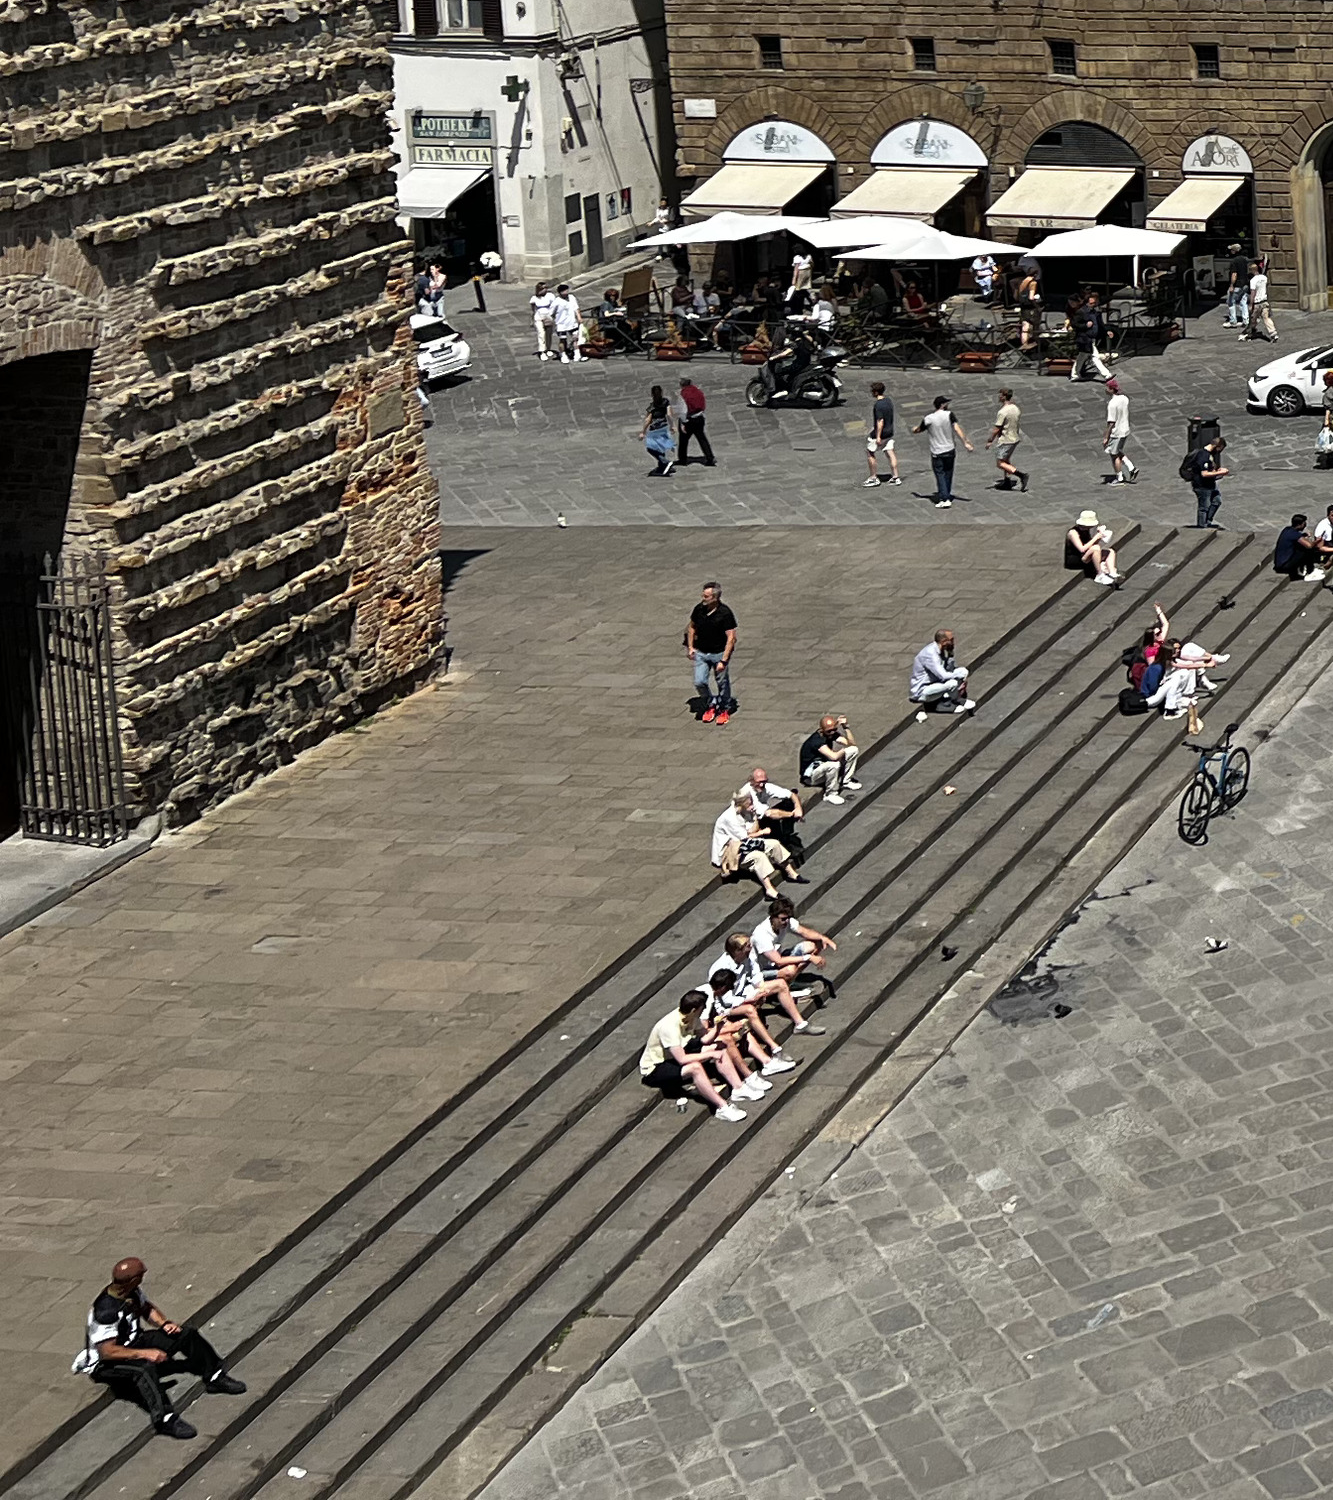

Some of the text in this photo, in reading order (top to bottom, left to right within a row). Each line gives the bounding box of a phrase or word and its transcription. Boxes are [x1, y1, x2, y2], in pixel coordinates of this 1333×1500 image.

[418, 148, 489, 162] FARMACIA
[1030, 219, 1054, 228] BAR
[1153, 221, 1199, 231] GELATERIA
